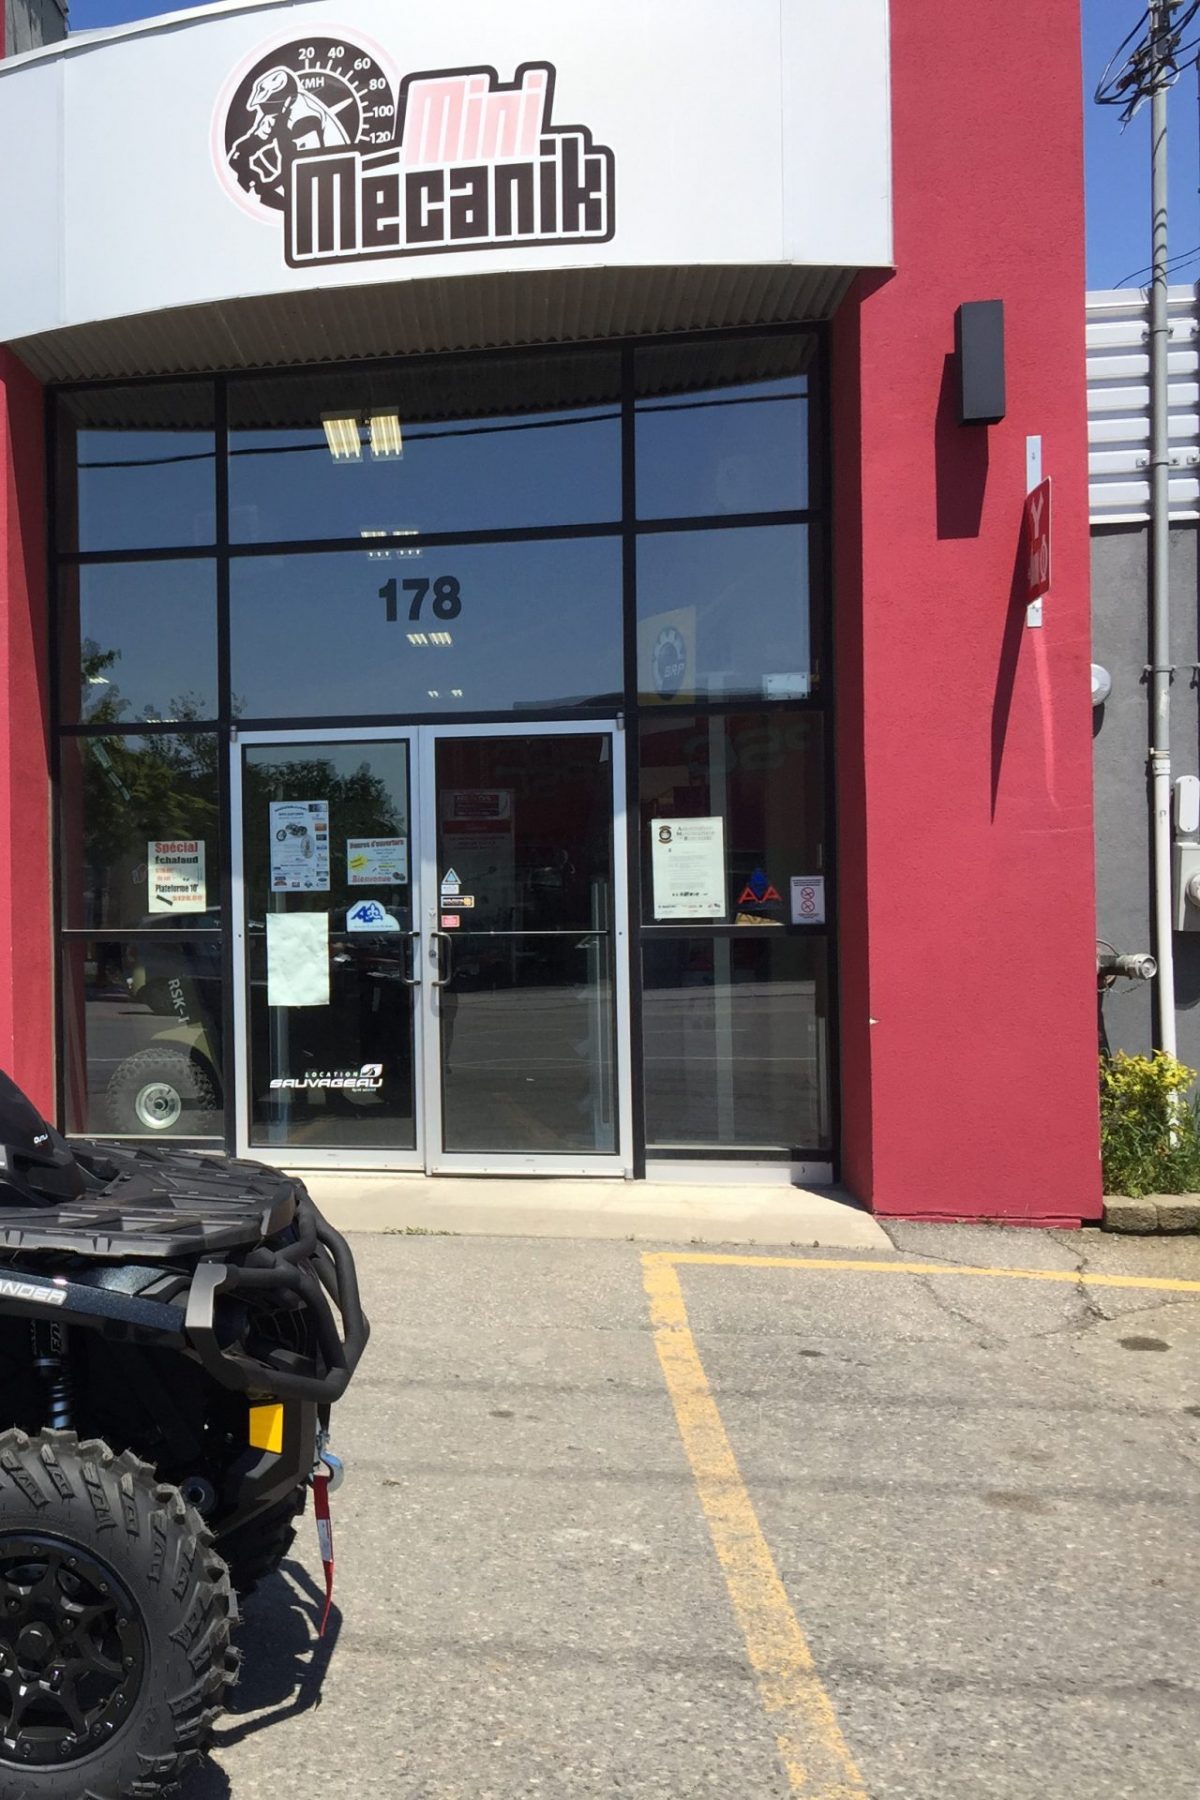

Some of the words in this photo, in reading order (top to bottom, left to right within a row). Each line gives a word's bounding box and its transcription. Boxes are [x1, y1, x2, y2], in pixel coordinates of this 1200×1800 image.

[298, 47, 315, 60] 20
[327, 46, 345, 58] 40
[353, 57, 371, 70] 60
[369, 78, 386, 90] 80
[372, 105, 394, 118] 100
[403, 73, 546, 168] Mini
[370, 131, 391, 144] 120
[378, 575, 462, 622] 178
[269, 1078, 383, 1089] SAUVAGEAU
